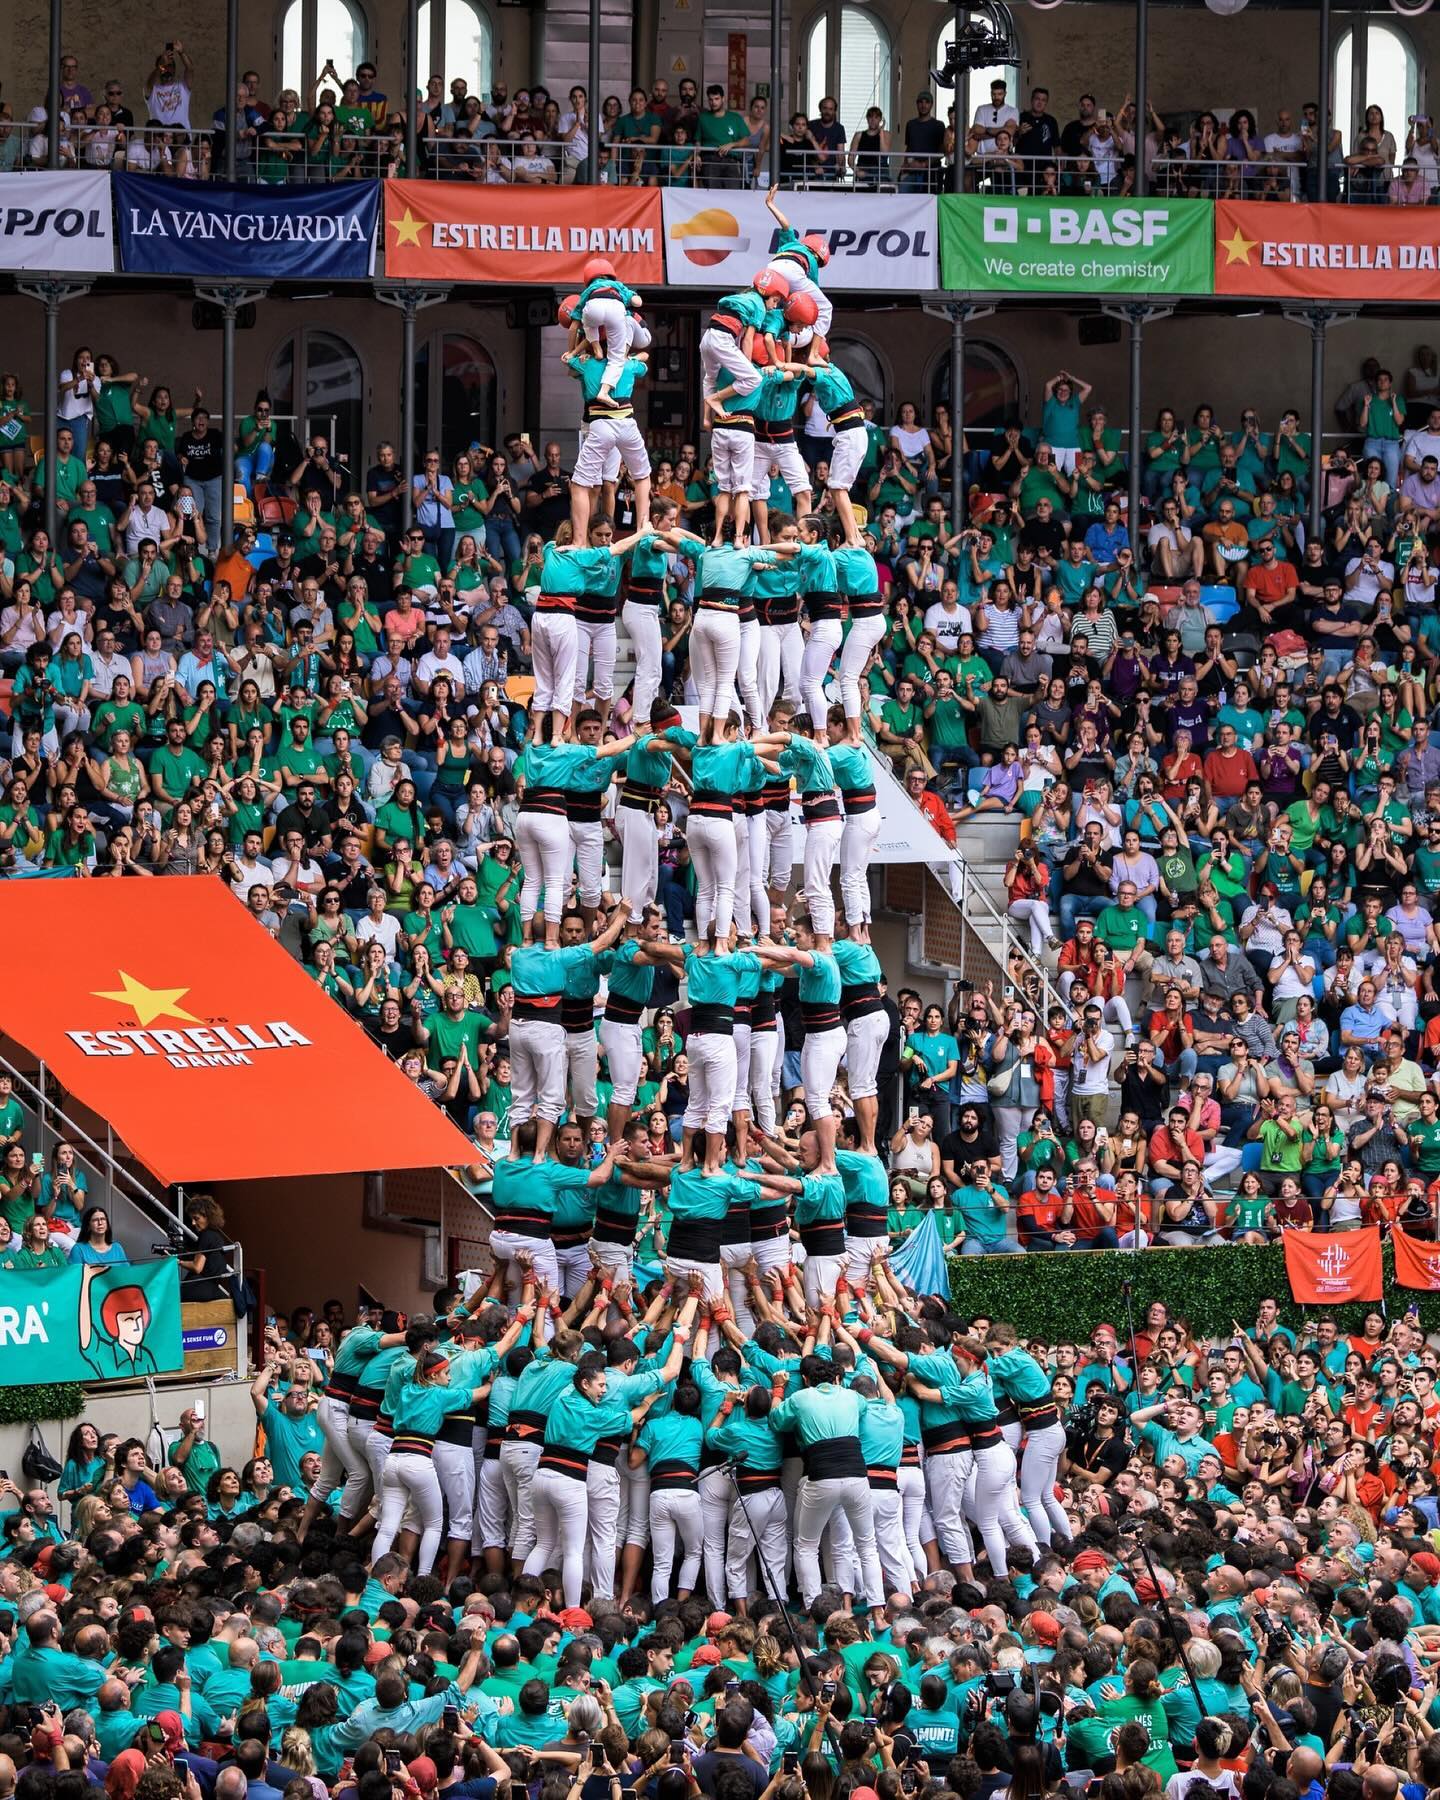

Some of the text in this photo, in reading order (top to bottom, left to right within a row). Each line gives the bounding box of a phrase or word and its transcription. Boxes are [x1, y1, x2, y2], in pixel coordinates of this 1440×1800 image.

[0, 207, 106, 238] PSOL
[130, 207, 368, 243] LA VANGUARDIA
[431, 222, 655, 253] ESTRELLA DAMM
[1049, 208, 1170, 247] BASF
[983, 258, 1171, 282] We create chemistry
[1261, 240, 1440, 270] ESTRELLA DA
[204, 1016, 230, 1024] 76
[64, 1021, 314, 1057] ESTRELLA
[164, 1051, 254, 1069] DAMM
[912, 1726, 955, 1743] AMUNT!
[1134, 1713, 1153, 1727] MÉS
